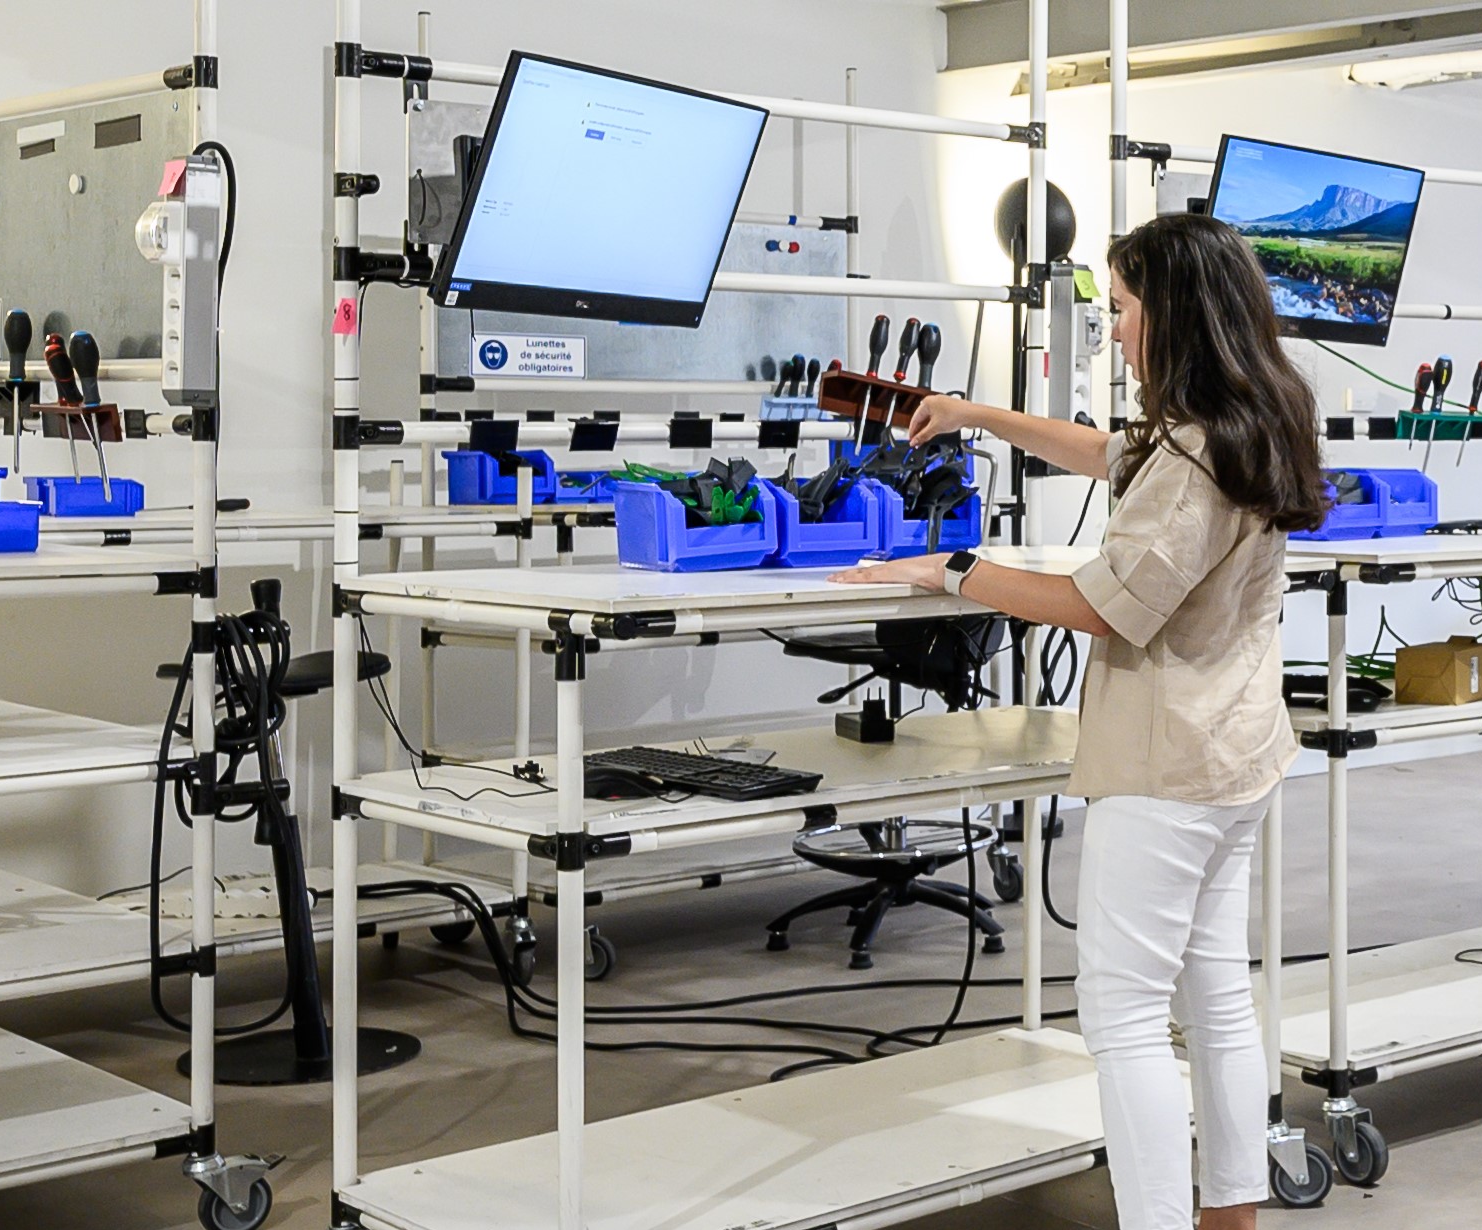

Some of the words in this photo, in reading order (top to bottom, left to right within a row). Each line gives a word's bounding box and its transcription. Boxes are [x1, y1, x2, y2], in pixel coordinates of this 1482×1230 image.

[343, 303, 352, 321] 8
[526, 339, 566, 349] Lunettes
[520, 351, 532, 360] de
[535, 351, 572, 361] sécurité
[518, 363, 574, 373] obligatoires
